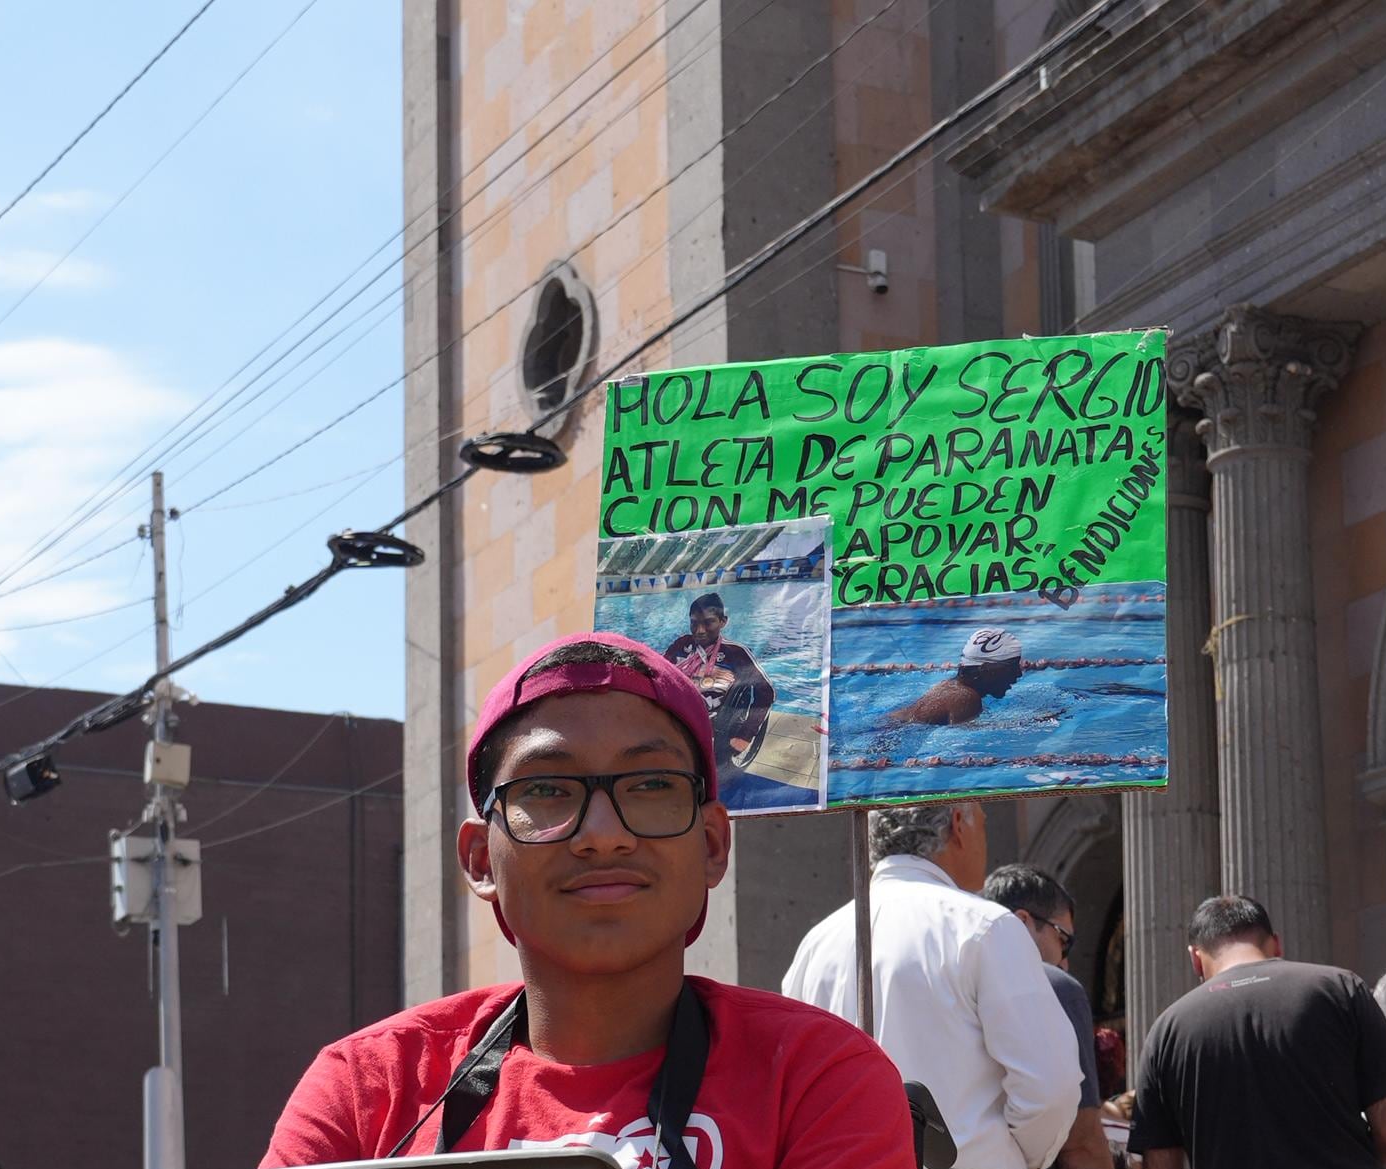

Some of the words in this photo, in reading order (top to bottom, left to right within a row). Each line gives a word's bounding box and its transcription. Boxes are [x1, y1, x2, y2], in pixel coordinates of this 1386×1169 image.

[612, 369, 771, 433] HOLA
[792, 362, 939, 430] SOY
[951, 349, 1165, 424] SERGIO
[602, 435, 774, 494] ATLETA
[795, 433, 867, 484] DE
[873, 423, 1134, 483] PARANATA
[602, 492, 742, 538] CION
[765, 485, 838, 523] ME
[844, 473, 1056, 526] PUEDEN
[1038, 425, 1166, 612] BENDICIONES
